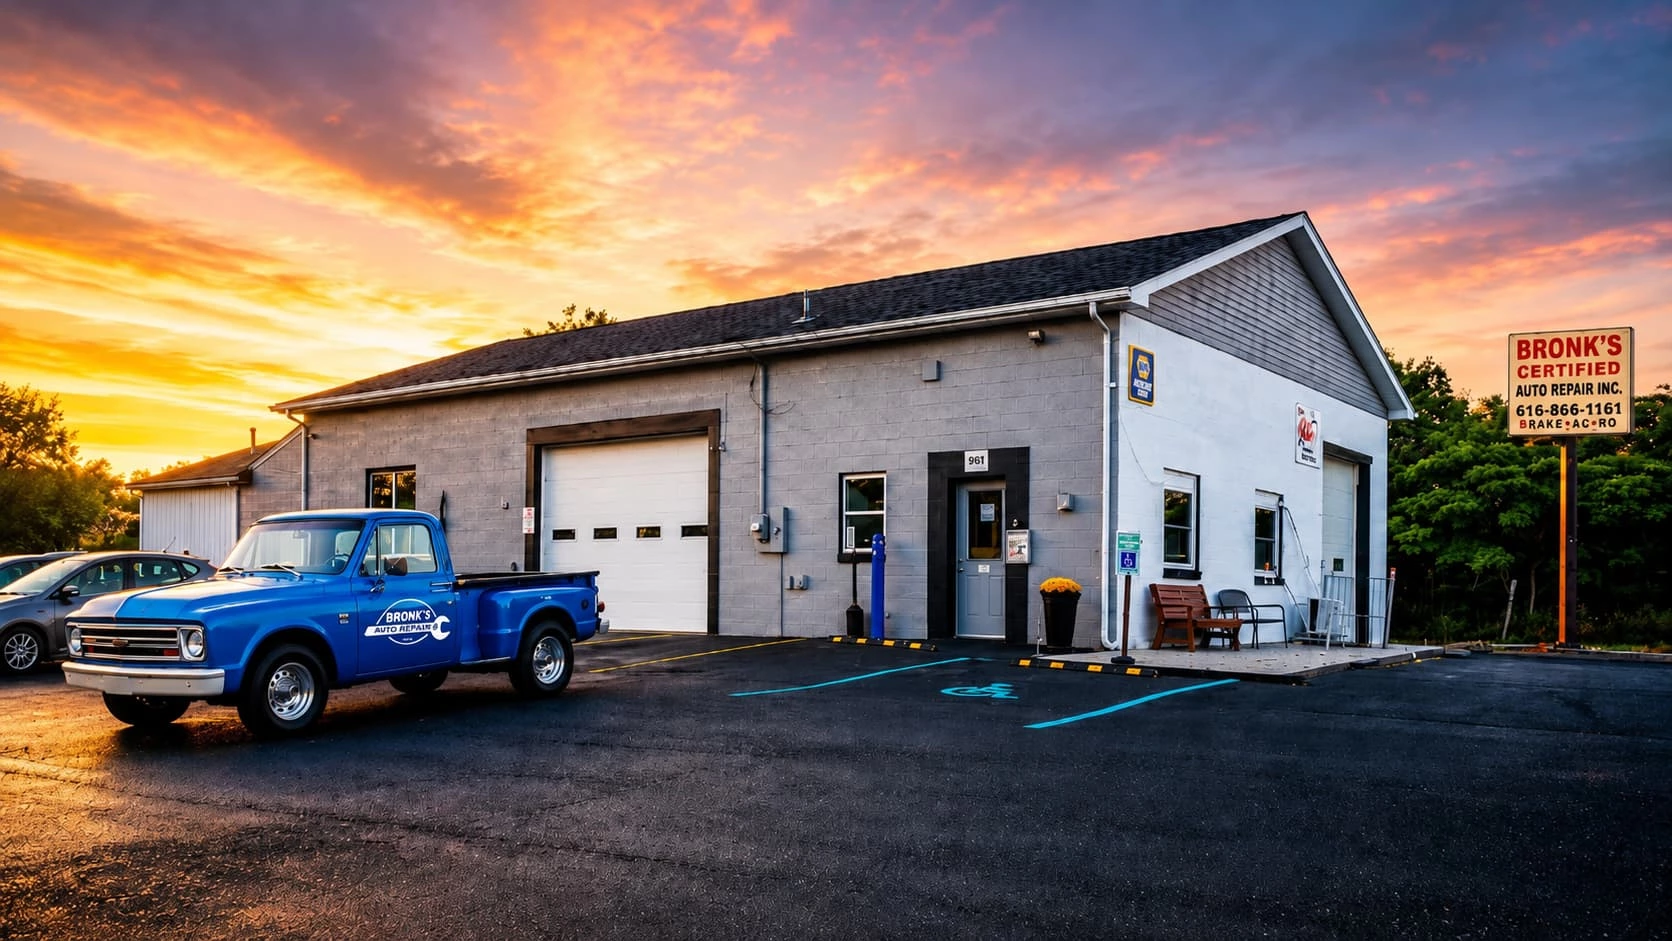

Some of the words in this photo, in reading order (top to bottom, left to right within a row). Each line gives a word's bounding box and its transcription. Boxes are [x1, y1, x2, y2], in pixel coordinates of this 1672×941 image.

[1517, 334, 1622, 360] BRONK'S
[1517, 361, 1620, 379] CERTIFIED
[1516, 384, 1547, 397] AUTO
[1551, 383, 1593, 396] REPAIR
[1598, 382, 1622, 395] INC.
[1516, 402, 1622, 416] 616-866-1161
[1519, 419, 1563, 429] BRAKE
[1572, 419, 1589, 428] AC
[1599, 418, 1617, 428] RO
[386, 610, 431, 623] BRONK'S
[399, 624, 431, 632] REPAIR
